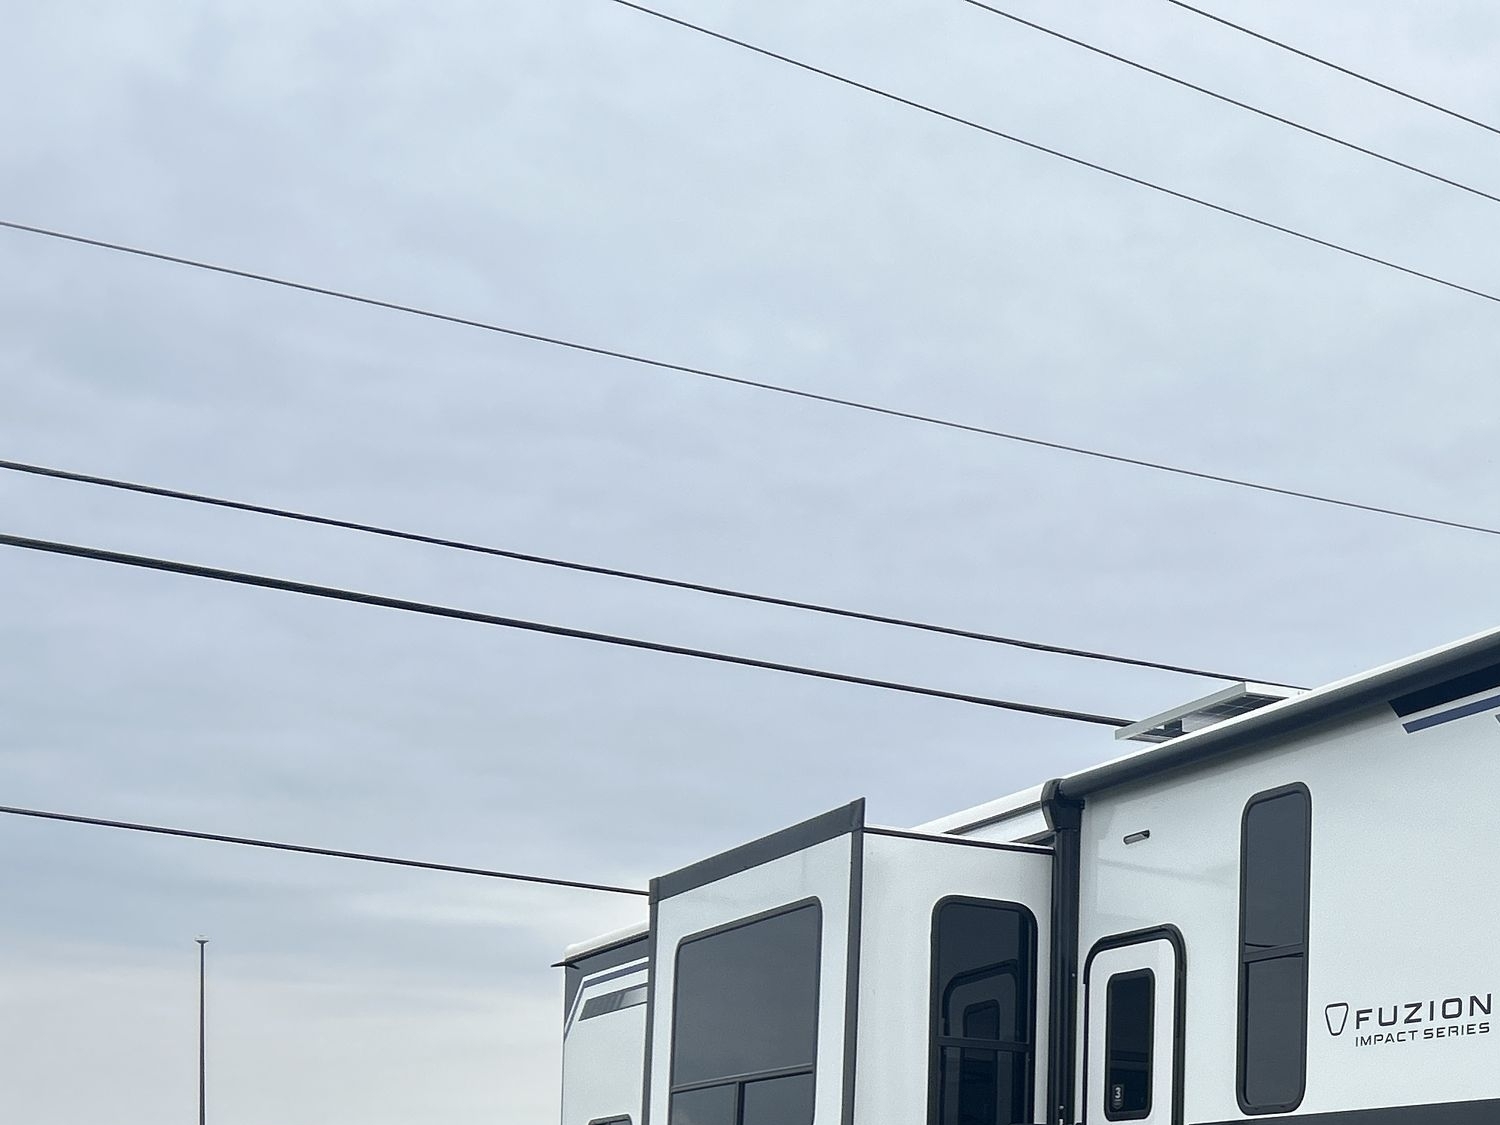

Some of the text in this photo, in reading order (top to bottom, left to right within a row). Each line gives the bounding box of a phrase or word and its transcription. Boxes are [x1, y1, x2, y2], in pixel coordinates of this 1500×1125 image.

[1355, 993, 1492, 1030] FUZION
[1355, 1021, 1491, 1047] IMPACT SERIES
